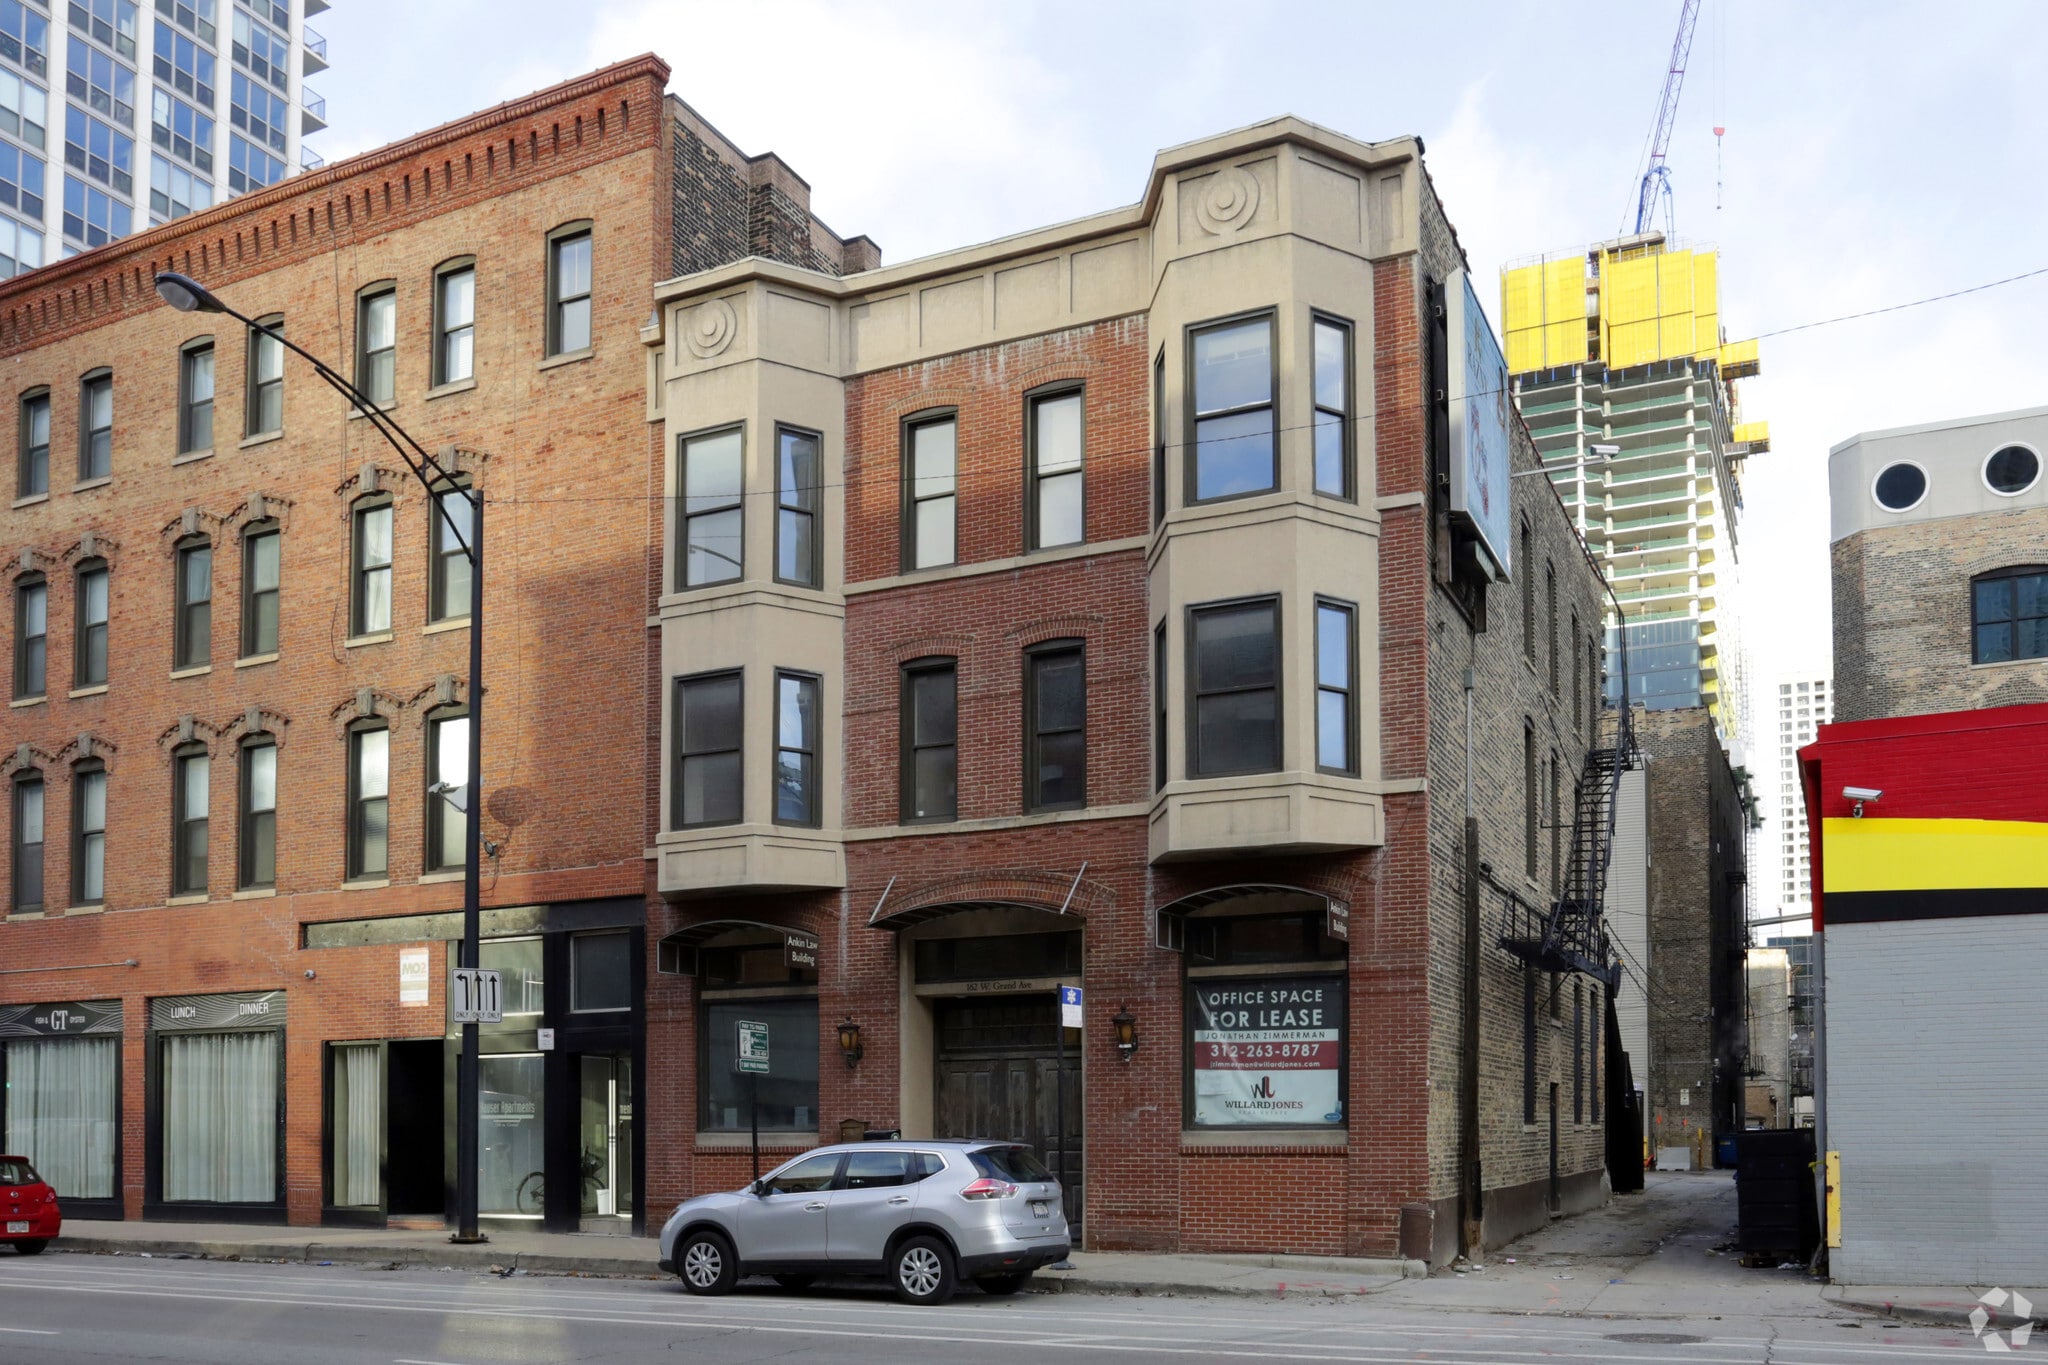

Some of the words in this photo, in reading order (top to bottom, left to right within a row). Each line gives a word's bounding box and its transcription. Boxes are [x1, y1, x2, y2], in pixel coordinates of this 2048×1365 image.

[787, 935, 805, 948] Ankin
[806, 939, 818, 949] Law
[792, 951, 815, 967] Building
[966, 983, 978, 992] 162
[993, 981, 1016, 990] Grand
[1020, 981, 1032, 989] Ave
[1209, 991, 1264, 1006] OFFICE
[1270, 989, 1323, 1004] SPACE
[170, 1006, 196, 1019] LUNCH
[239, 1002, 269, 1015] DINNER
[51, 1010, 68, 1031] GT
[1209, 1010, 1250, 1028] FOR
[1260, 1008, 1323, 1027] LEASE
[1206, 1032, 1259, 1040] JONATHAN
[1263, 1031, 1325, 1040] ZIMMERMAN
[1210, 1043, 1320, 1058] 312-263-8787
